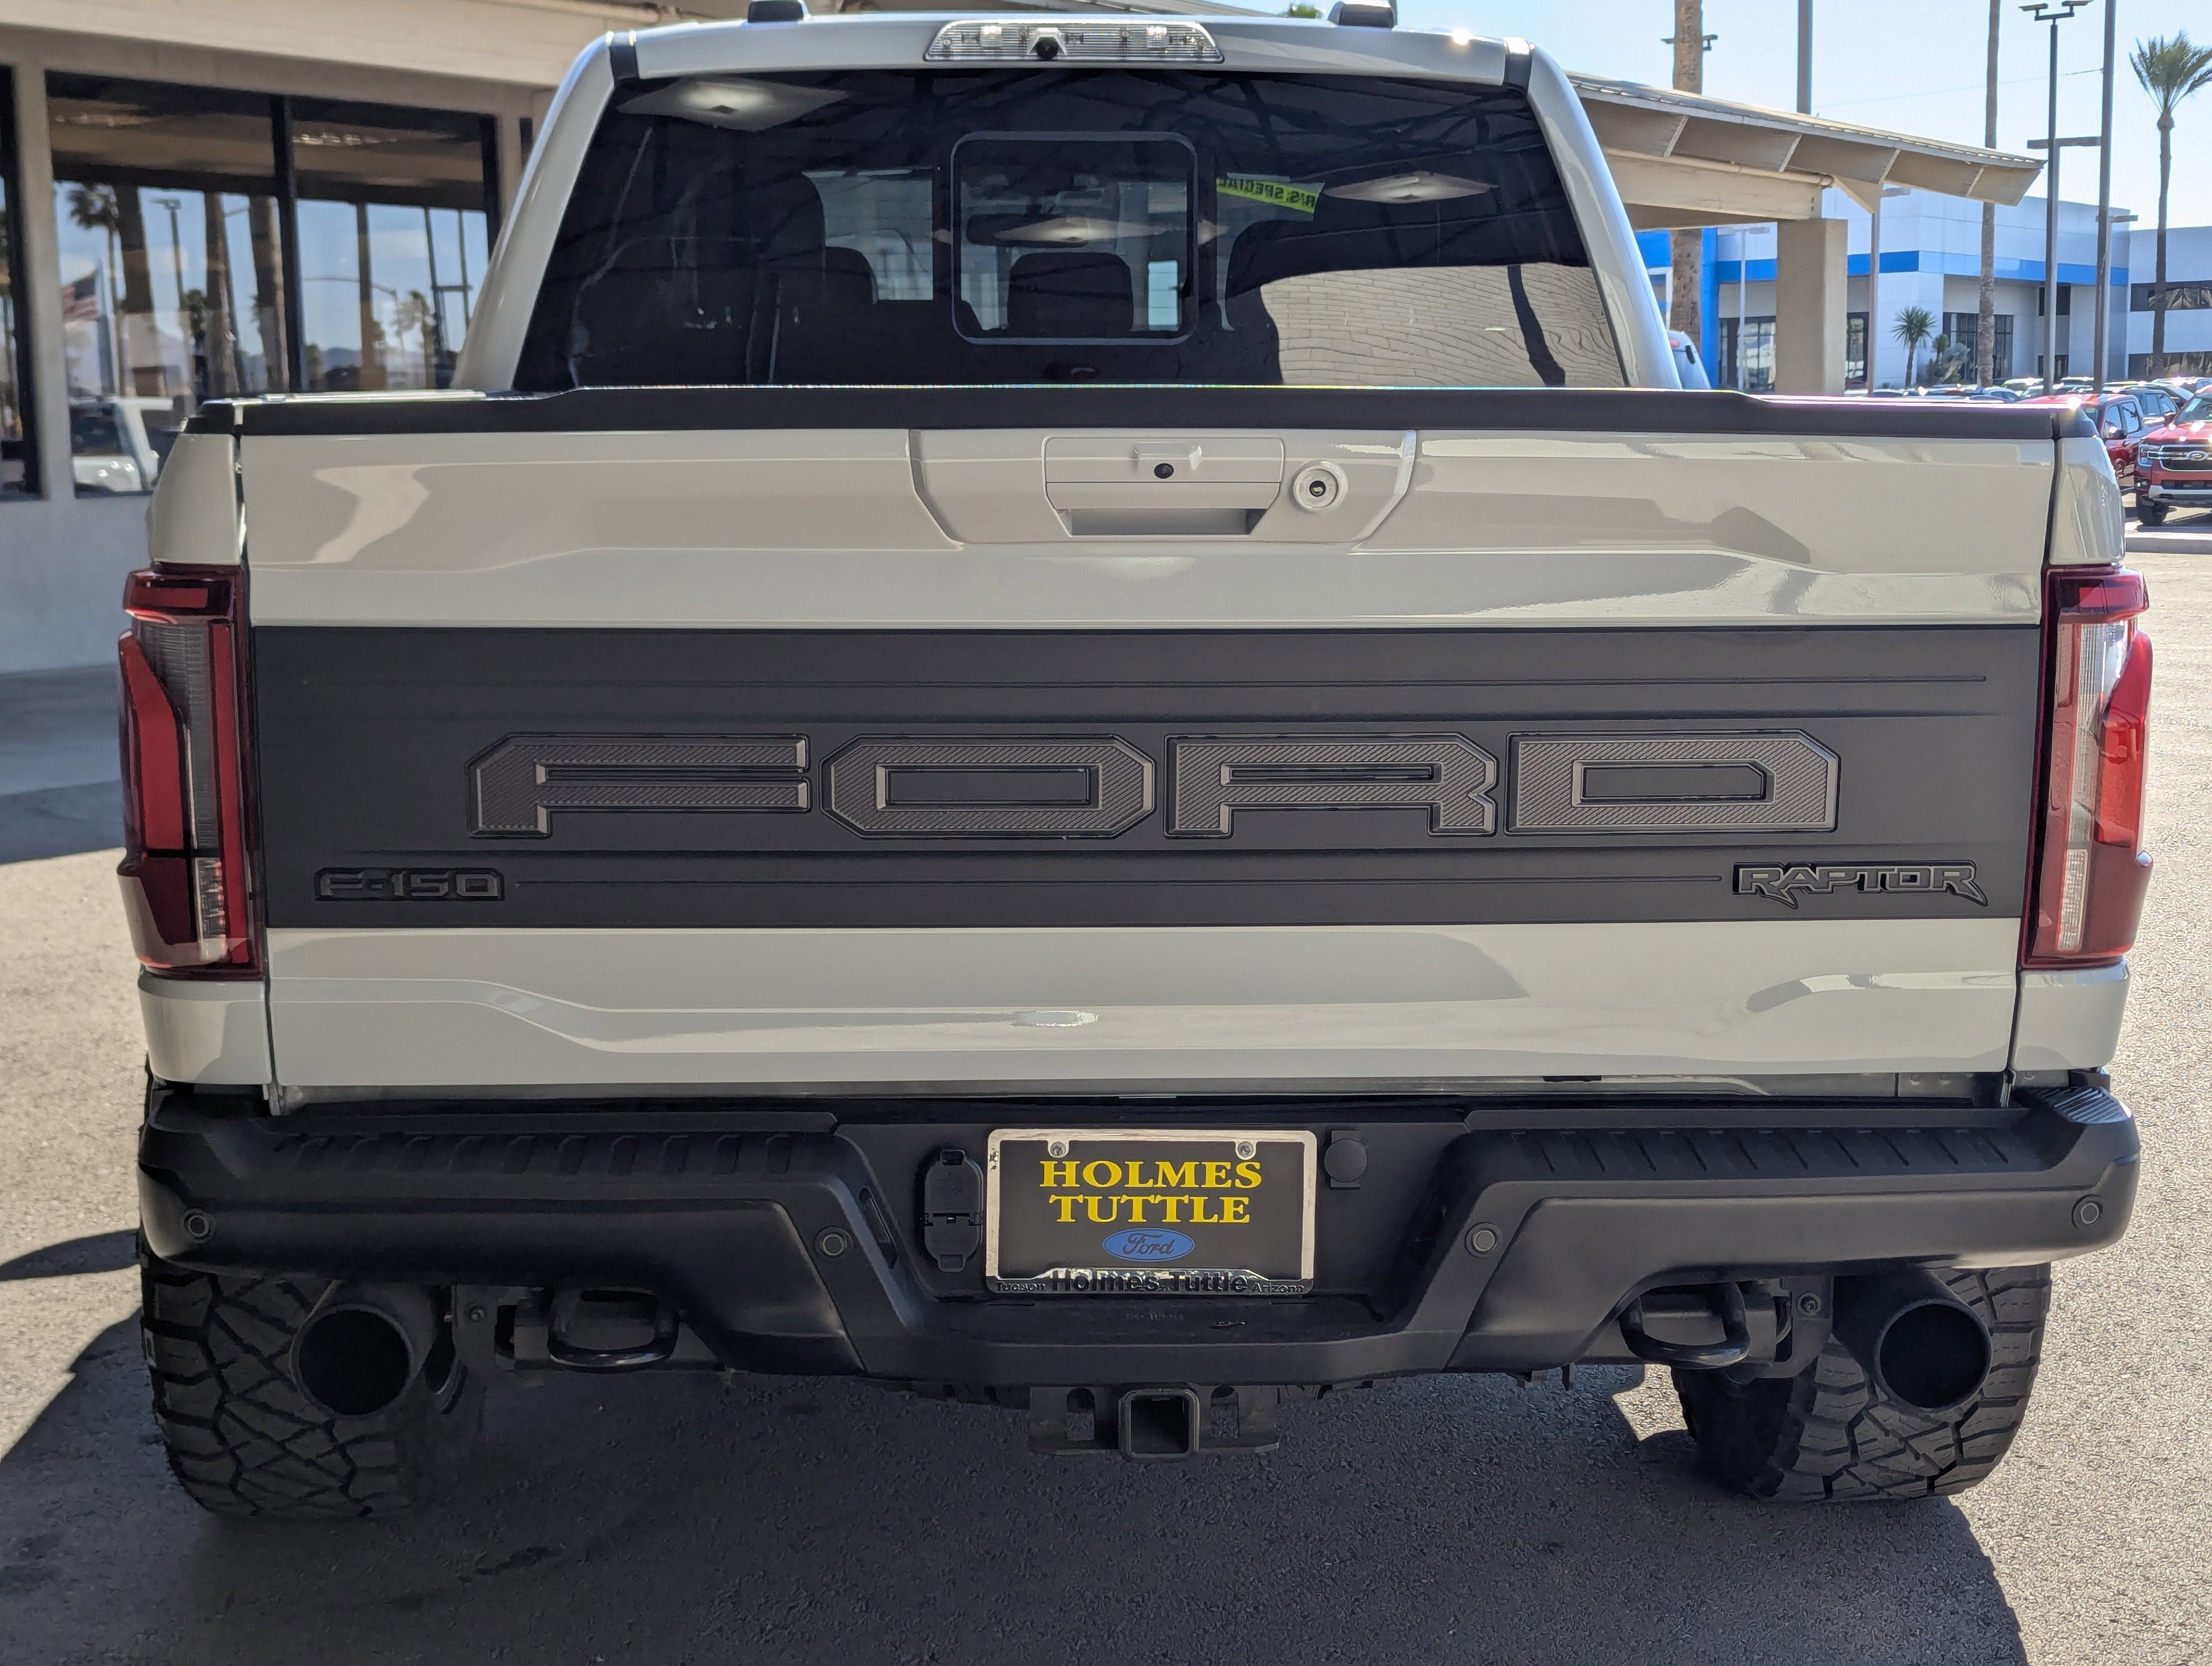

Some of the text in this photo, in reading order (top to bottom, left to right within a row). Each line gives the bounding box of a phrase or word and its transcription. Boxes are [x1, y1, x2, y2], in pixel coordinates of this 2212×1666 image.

[467, 731, 1841, 840] FORD
[314, 868, 504, 901] F-150
[1733, 861, 1988, 909] RAPTOR
[1039, 1160, 1262, 1188] HOLMES
[1049, 1194, 1250, 1223] TUTTLE
[1122, 1233, 1175, 1255] Ford
[995, 1268, 1304, 1293] Tucson Holmes Tuttle Arizona
